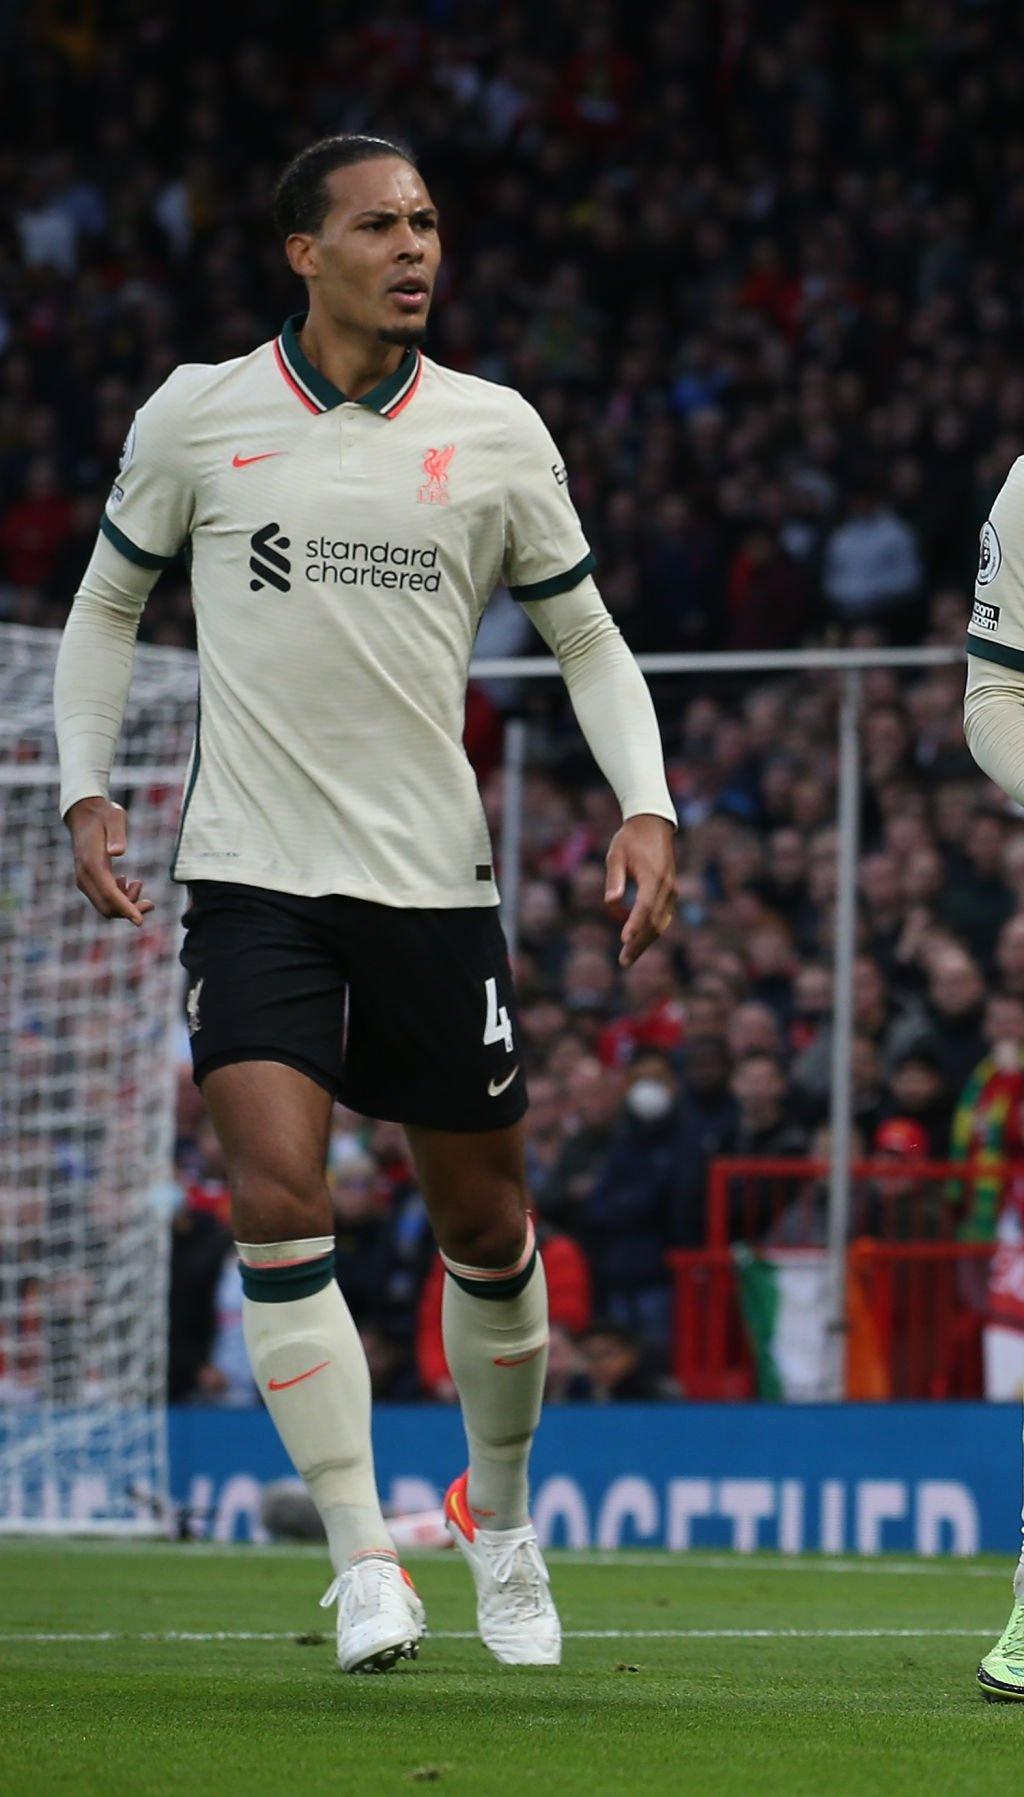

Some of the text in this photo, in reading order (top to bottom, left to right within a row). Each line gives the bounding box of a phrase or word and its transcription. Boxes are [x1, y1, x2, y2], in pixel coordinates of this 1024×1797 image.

[305, 536, 438, 568] standard
[305, 560, 441, 593] chartered
[483, 977, 513, 1053] 4
